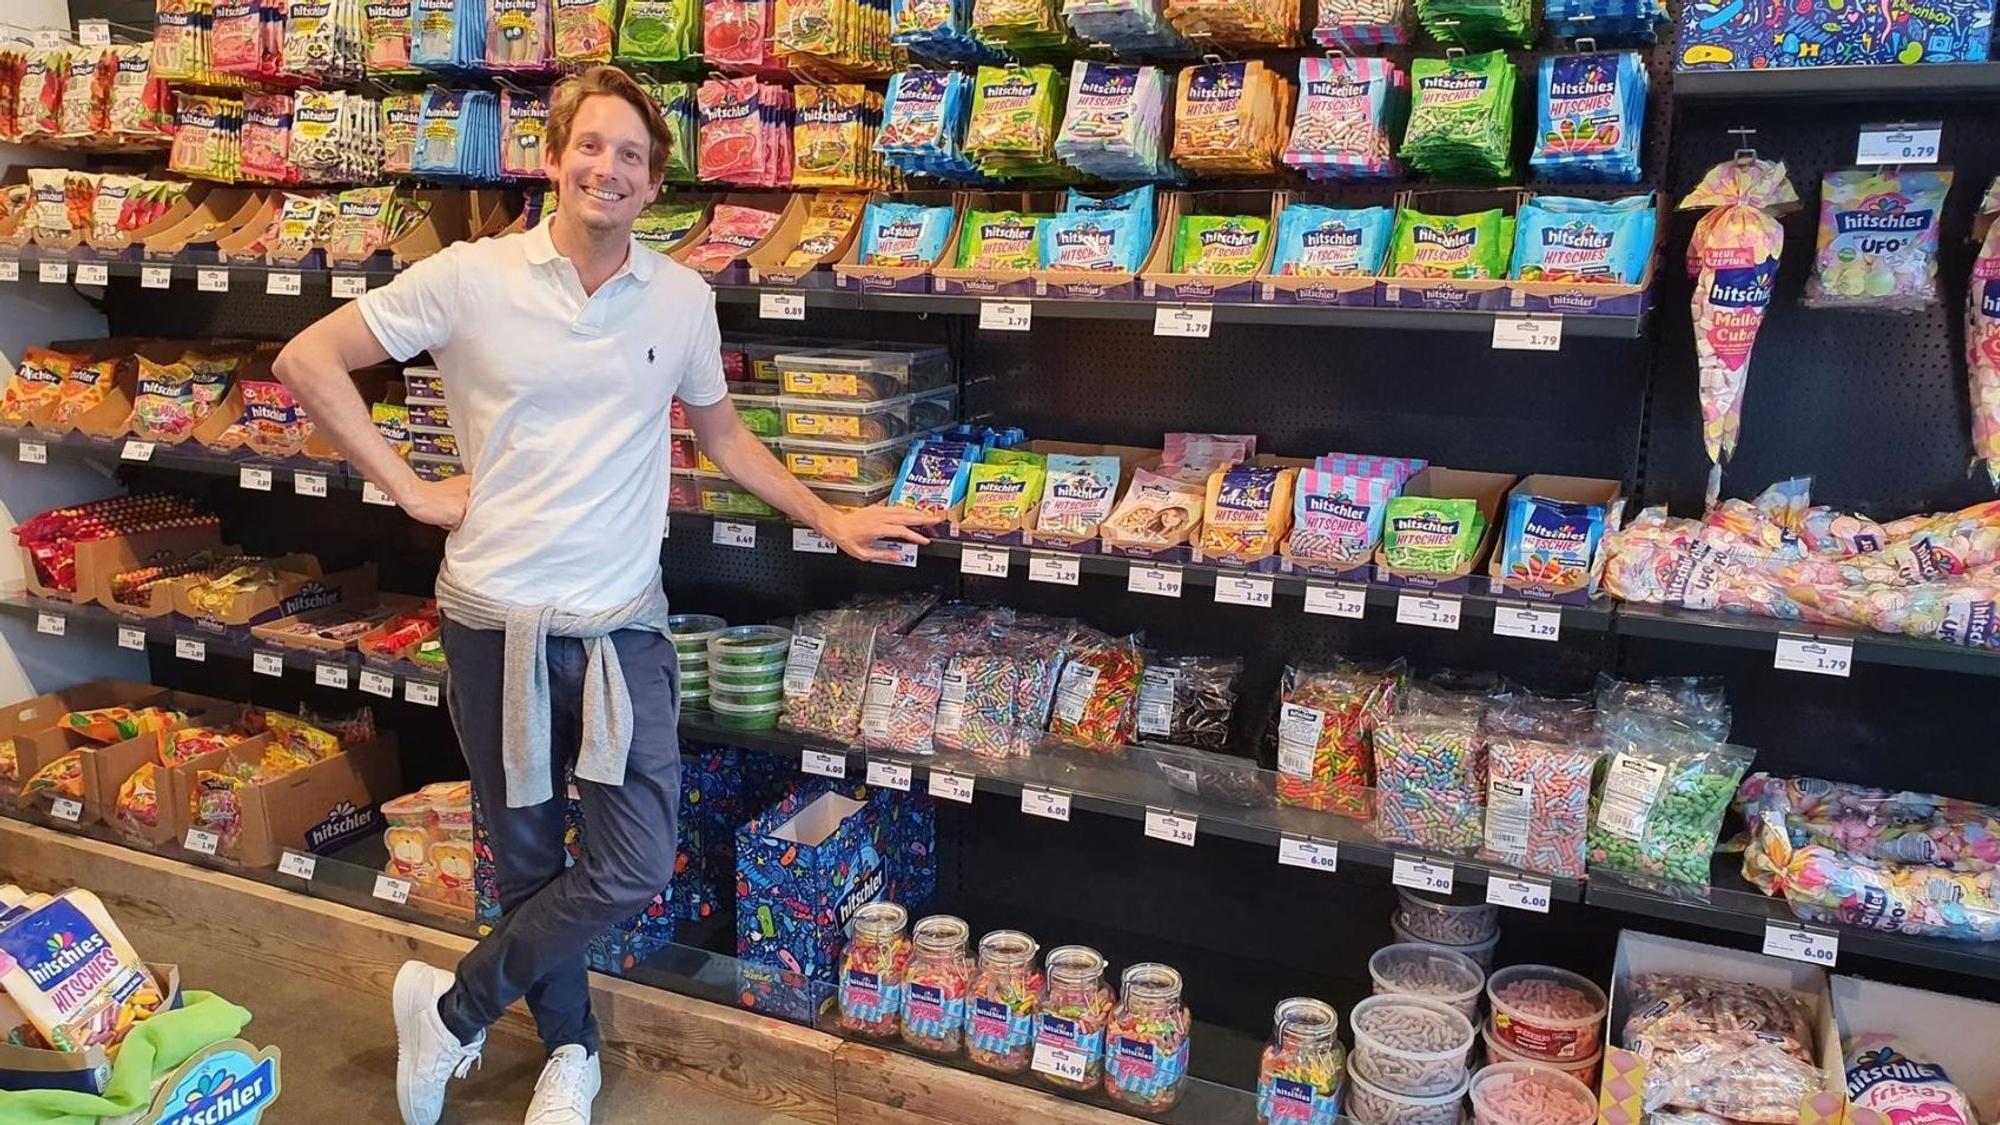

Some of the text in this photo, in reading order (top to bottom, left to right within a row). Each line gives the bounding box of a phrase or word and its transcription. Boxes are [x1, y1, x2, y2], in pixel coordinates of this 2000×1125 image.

[1424, 78, 1481, 89] hitschler
[1552, 82, 1614, 94] hitschies
[988, 86, 1034, 97] hitschler
[1082, 84, 1132, 95] hitschies
[1189, 87, 1241, 98] hitschies
[1312, 84, 1365, 97] hitschler
[1551, 95, 1611, 115] HITSCHIES
[1903, 147, 1935, 157] 0.79
[1845, 215, 1923, 229] hitschler
[985, 226, 1029, 239] hitschler
[1308, 232, 1358, 245] hitschler
[1548, 229, 1608, 248] hitschler
[1544, 249, 1606, 263] HITSCHIES
[1553, 295, 1593, 307] hitschler
[1186, 323, 1207, 332] 1.79
[1530, 335, 1556, 345] 1.79
[1310, 499, 1365, 519] hitschler
[1307, 517, 1361, 533] HITSCHIES
[1399, 520, 1454, 533] hitschler
[1526, 523, 1585, 541] hitschies
[736, 535, 753, 544] 6.49
[1397, 533, 1451, 545] HITSCHIES
[988, 564, 1005, 572] 1.29
[1056, 572, 1076, 580] 1.29
[1158, 582, 1178, 592] 1.99
[1246, 592, 1269, 601] 1.29
[1337, 603, 1360, 613] 1.29
[1432, 613, 1456, 623] 1.29
[1530, 624, 1556, 635] 1.29
[1817, 658, 1847, 670] 1.79
[826, 765, 843, 775] 6.00
[890, 777, 909, 786] 6.00
[953, 788, 970, 798] 7.00
[1047, 806, 1066, 816] 6.00
[312, 810, 373, 845] hitschler
[1172, 830, 1192, 841] 3.50
[1311, 856, 1334, 867] 6.00
[1426, 877, 1450, 889] 7.00
[839, 869, 884, 923] hitschler
[1521, 896, 1546, 907] 6.00
[28, 932, 104, 985] hitschies
[1804, 948, 1833, 960] 6.00
[51, 947, 119, 1015] HITSCHIES
[1055, 1062, 1082, 1076] 14.99
